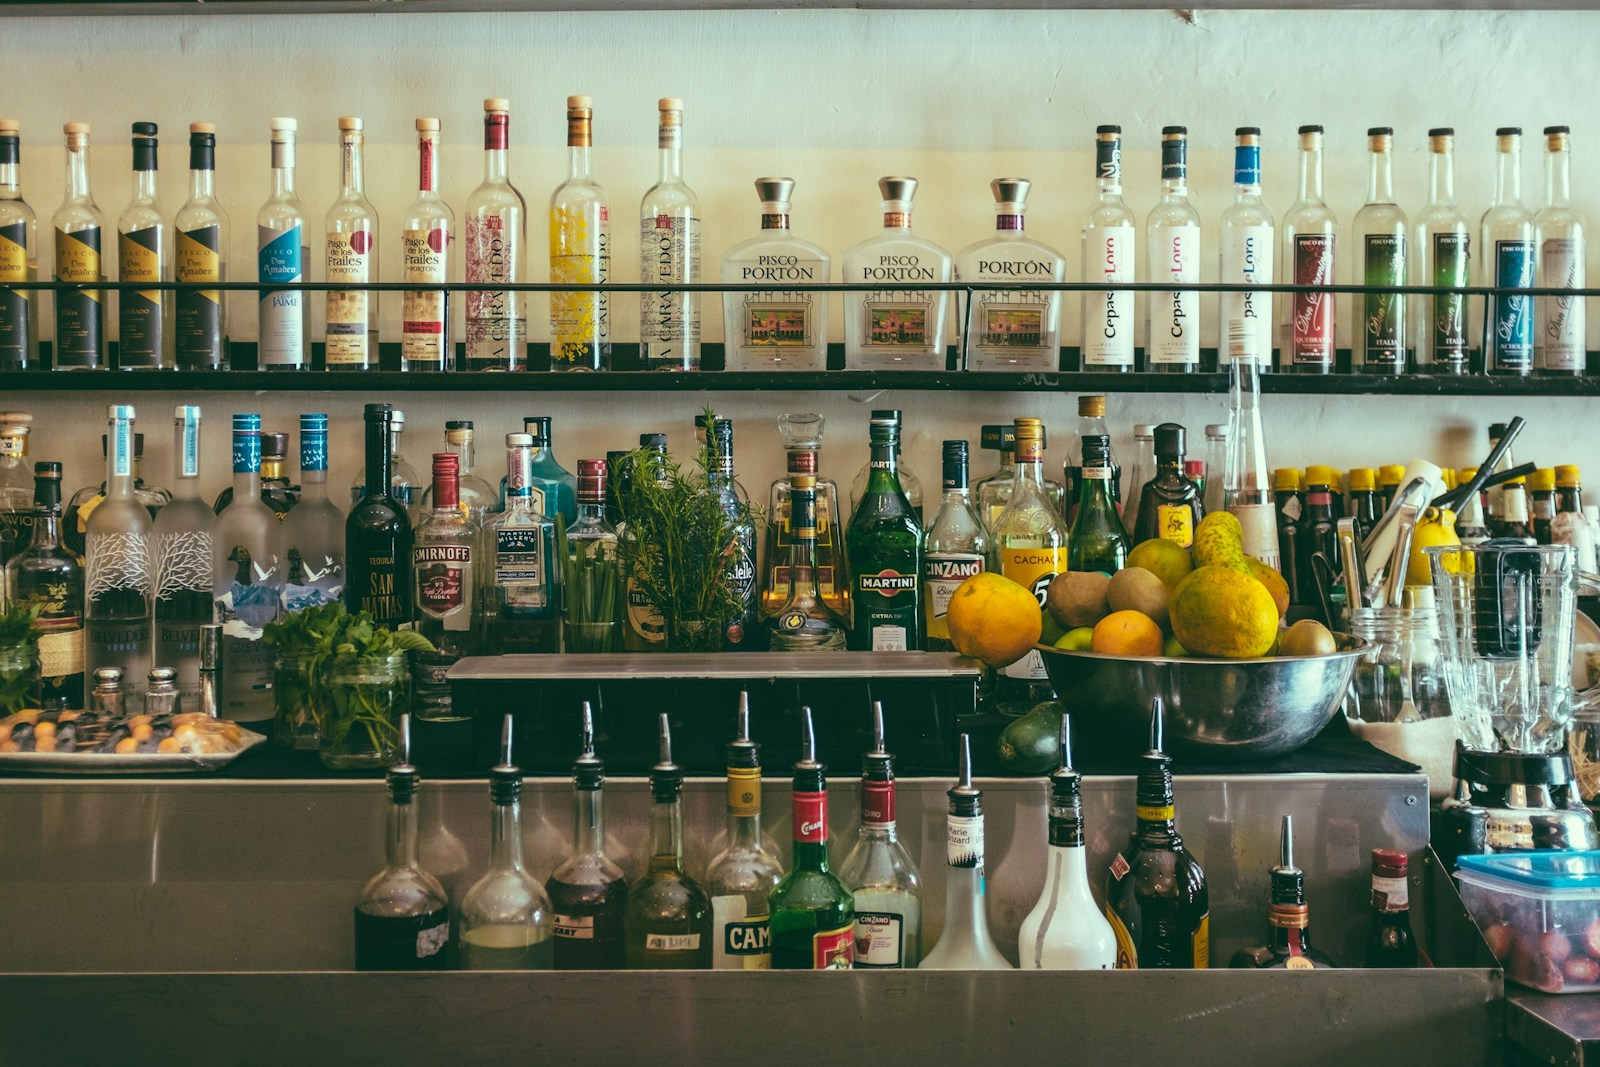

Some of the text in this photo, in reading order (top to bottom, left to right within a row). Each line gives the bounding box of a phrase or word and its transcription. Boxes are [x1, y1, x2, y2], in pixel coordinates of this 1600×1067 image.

[327, 240, 347, 249] Pago
[405, 238, 425, 247] Pago
[271, 256, 286, 264] Don
[328, 256, 362, 266] Frailes
[405, 254, 439, 265] Frailes
[759, 255, 798, 266] PISCO
[880, 255, 919, 266] PISCO
[742, 265, 813, 281] PORTÓN
[863, 265, 934, 281] PORTÓN
[979, 260, 1051, 276] PORTÓN
[498, 535, 534, 543] MILLER'S
[415, 548, 468, 561] SMIRNOFF
[369, 557, 394, 565] TEQUILA
[925, 561, 980, 578] CINZANO
[371, 571, 393, 595] SAN
[863, 577, 914, 588] MARTINI
[1034, 578, 1050, 608] 5
[361, 595, 402, 620] MATIAS
[107, 643, 137, 651] VODKA
[860, 916, 889, 924] CINZANO
